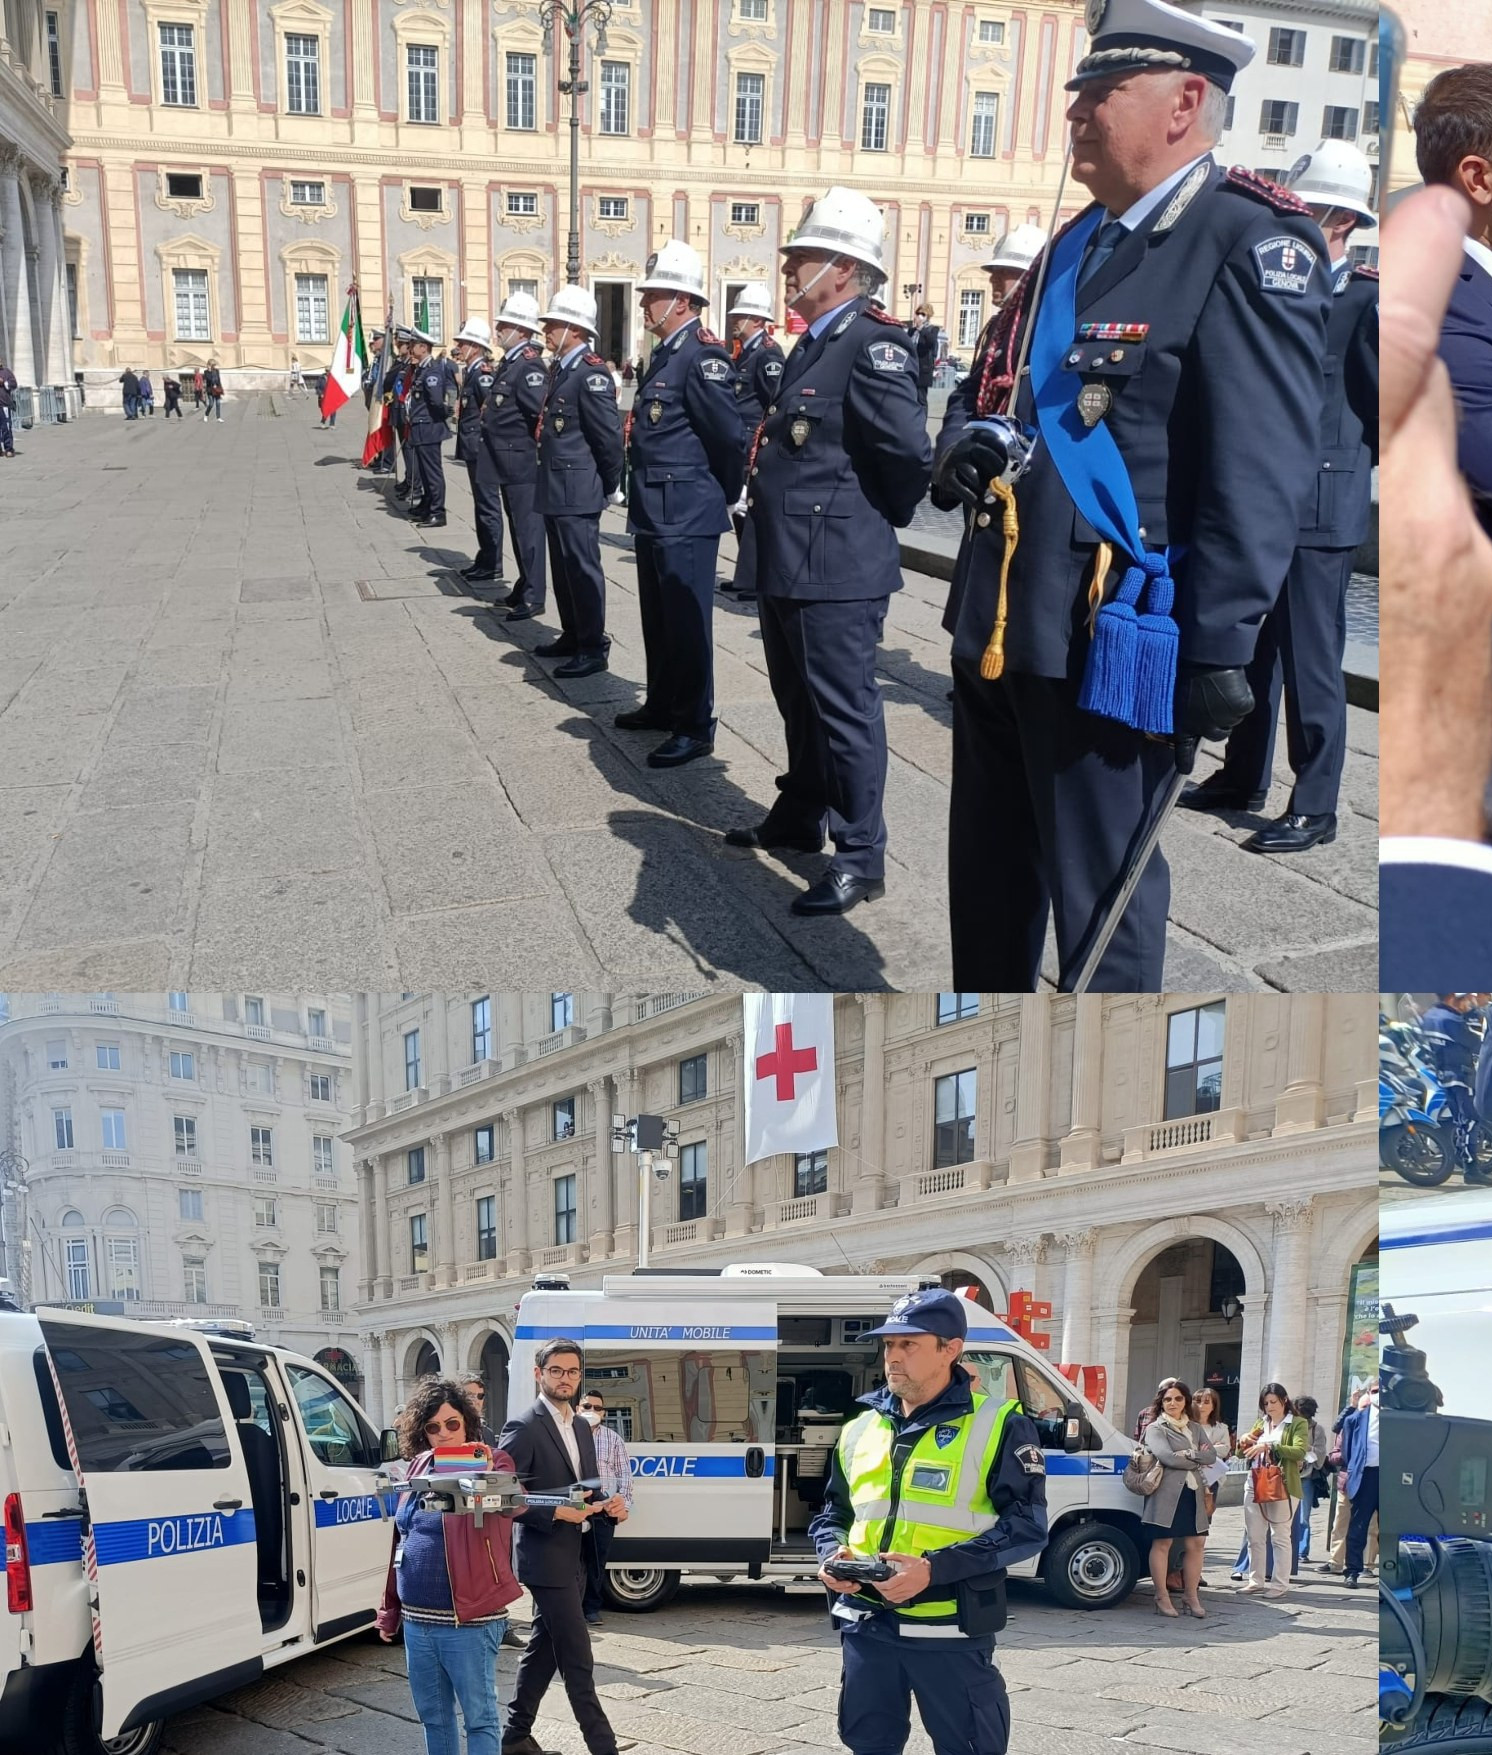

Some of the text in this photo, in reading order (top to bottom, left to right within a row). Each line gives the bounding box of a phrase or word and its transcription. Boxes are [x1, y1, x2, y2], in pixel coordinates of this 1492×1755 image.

[682, 1327, 731, 1339] MOBILE
[630, 1457, 697, 1477] OCALE
[336, 1497, 373, 1523] LOCALE
[148, 1515, 224, 1555] POLIZIA
